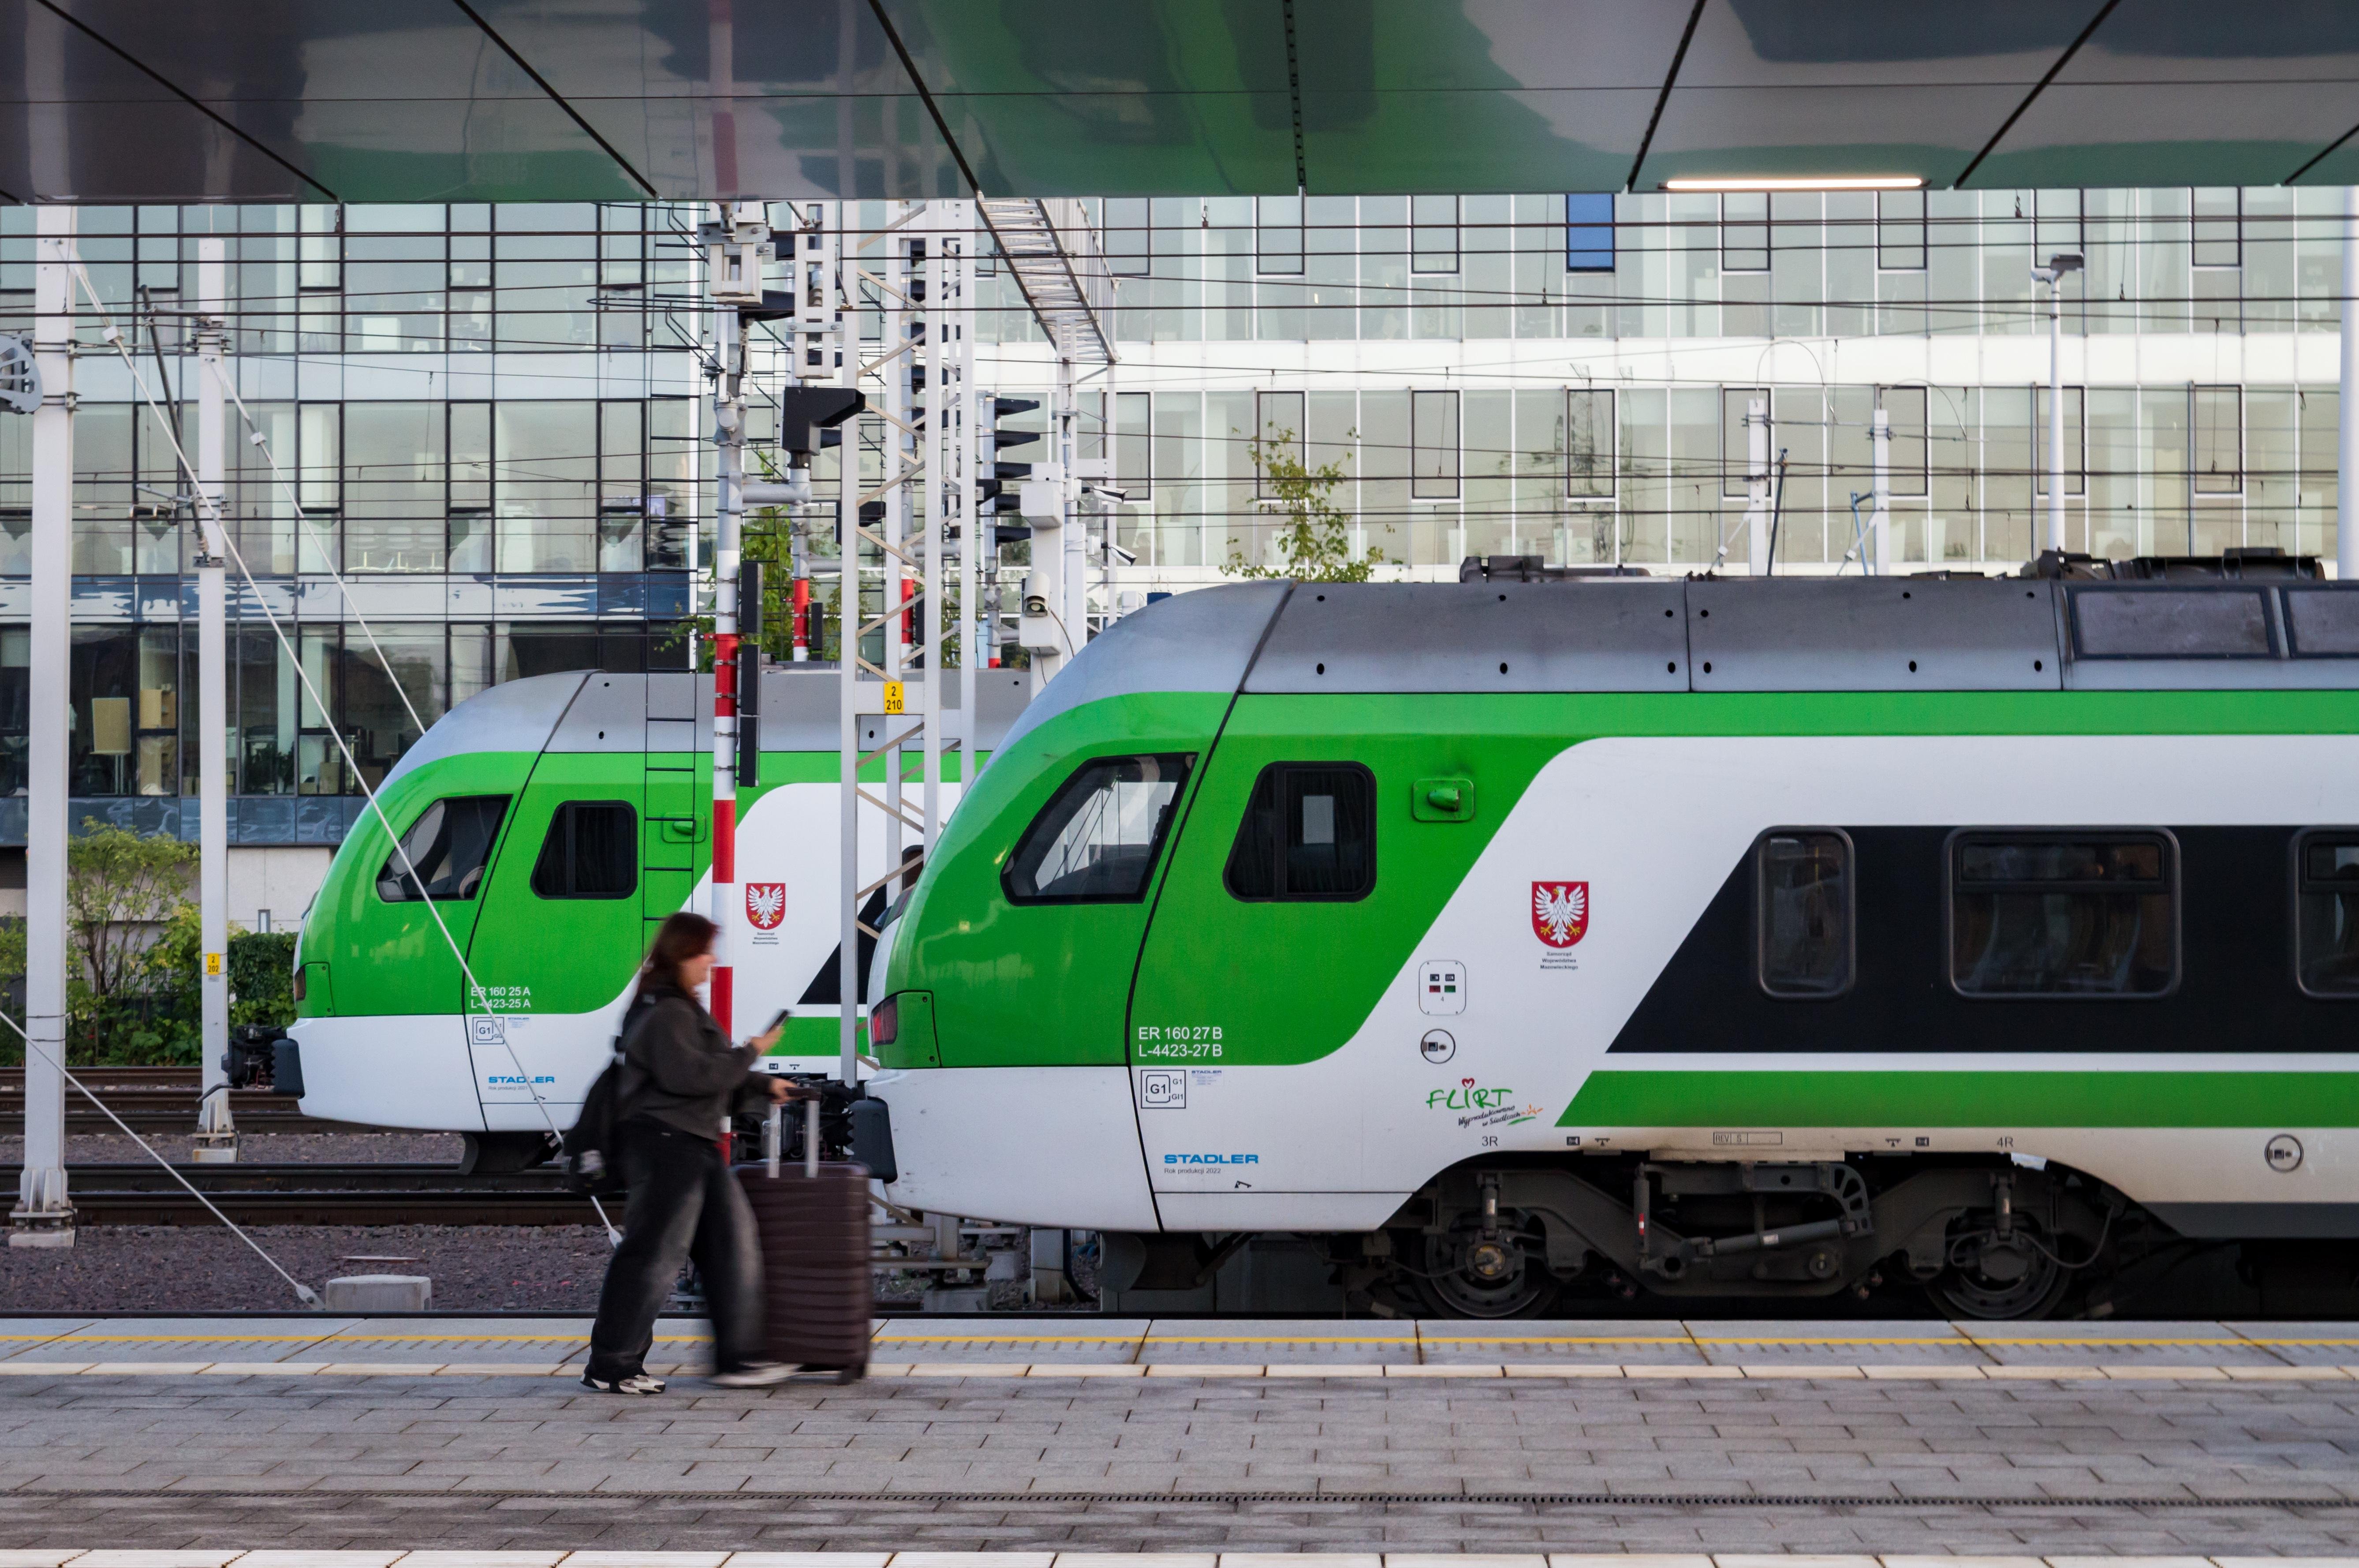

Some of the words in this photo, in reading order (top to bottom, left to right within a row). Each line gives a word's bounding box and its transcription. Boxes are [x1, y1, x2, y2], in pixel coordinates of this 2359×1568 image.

[892, 686, 896, 696] 2
[886, 700, 902, 710] 210
[471, 987, 486, 996] ER
[489, 987, 506, 996] 160
[508, 987, 521, 996] 25
[523, 987, 531, 996] A
[523, 999, 531, 1008] A
[1139, 1027, 1160, 1040] ER
[1165, 1027, 1190, 1040] 160
[1193, 1027, 1210, 1040] 27
[1213, 1027, 1222, 1040] B
[1139, 1044, 1210, 1057] L-4423-27
[1213, 1044, 1222, 1057] B
[1150, 1084, 1165, 1094] G1
[1426, 1088, 1512, 1110] FLIRT
[1482, 1136, 1498, 1147] 3R
[1997, 1137, 2013, 1147] 4R
[1164, 1154, 1258, 1164] STADLER
